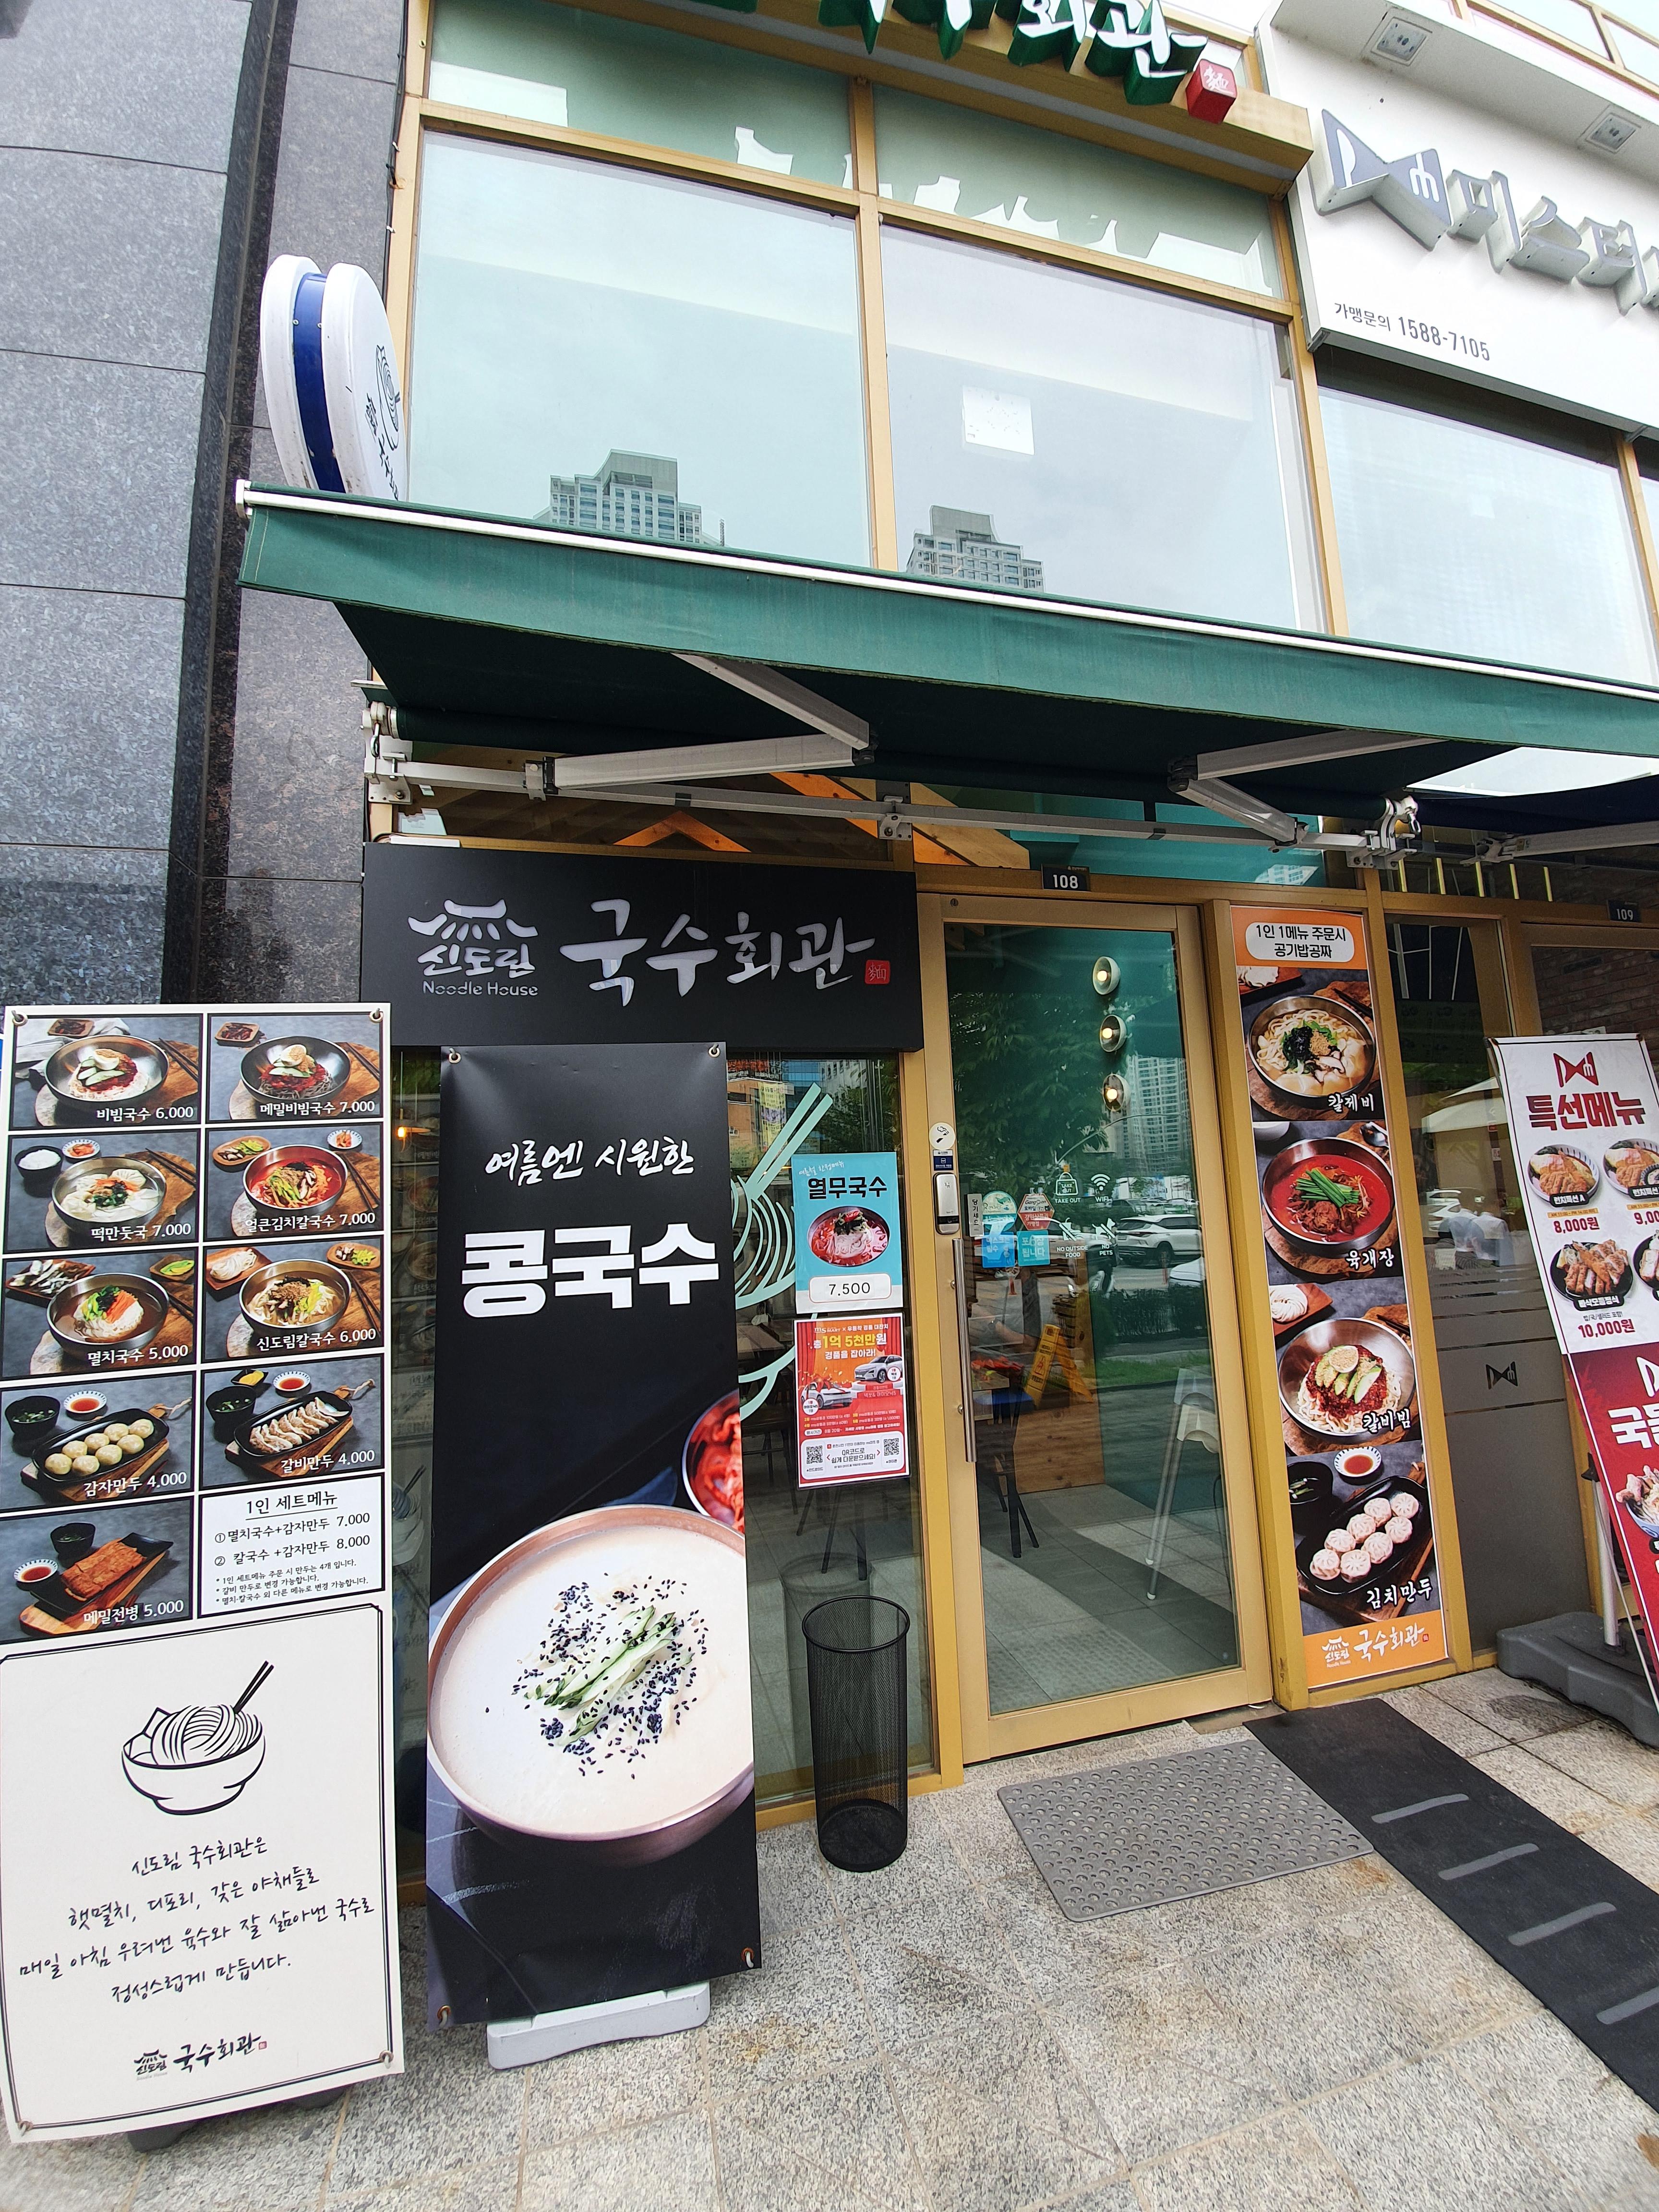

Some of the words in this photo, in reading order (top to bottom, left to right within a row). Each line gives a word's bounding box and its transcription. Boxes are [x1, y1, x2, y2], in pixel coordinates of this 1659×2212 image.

[1446, 170, 1659, 305] 미스터
[1334, 303, 1391, 331] 가맹문의
[1399, 317, 1490, 361] 1588-7105
[1053, 874, 1078, 889] 108
[1616, 908, 1634, 920] 109
[1255, 924, 1275, 939] 1인
[1278, 925, 1309, 940] 1메뉴
[1311, 926, 1346, 942] 주문시
[417, 943, 536, 978] 신도림
[559, 899, 876, 1008] 국수회관
[1274, 943, 1332, 959] 공기밥공짜
[423, 980, 483, 995] Noodle
[487, 982, 538, 996] House
[96, 1107, 152, 1122] 비빔국수
[156, 1106, 194, 1120] 6.000
[259, 1102, 336, 1118] 메밀비빔국수
[340, 1100, 375, 1114] 7.000
[1328, 1092, 1374, 1113] 칼제비
[1526, 1091, 1647, 1131] 특선메뉴
[484, 1139, 583, 1187] 여름엔
[595, 1136, 695, 1177] 시원한
[807, 1176, 888, 1200] 열무국수
[91, 1226, 148, 1242] 떡만둣국
[153, 1223, 192, 1238] 7.000
[245, 1214, 336, 1233] 얼큰김치칼국수
[339, 1211, 376, 1226] 7.000
[1553, 1217, 1600, 1234] 8,000원
[1022, 1248, 1045, 1258] 됩니다
[1346, 1248, 1395, 1270] 육개장
[461, 1223, 720, 1318] 콩국수
[828, 1281, 870, 1297] 7.500
[256, 1331, 336, 1352] 신도림칼국수
[339, 1328, 376, 1343] 6.000
[845, 1333, 887, 1347] 5천만원
[1578, 1319, 1635, 1338] 10,000원
[87, 1349, 144, 1367] 멸치국수
[148, 1345, 189, 1360] 5.000
[825, 1350, 848, 1360] 경품을
[851, 1348, 876, 1358] 잡아라!
[1362, 1408, 1411, 1433] 칼비빔
[280, 1455, 334, 1475] 갈비만두
[337, 1449, 375, 1466] 4.000
[842, 1447, 865, 1455] QR코드로
[84, 1477, 142, 1496] 감자만두
[147, 1471, 187, 1488] 4.000
[246, 1497, 270, 1515] 1인
[276, 1491, 338, 1510] 세트메뉴
[337, 1512, 371, 1527] 7.000
[233, 1549, 270, 1565] 칼국수
[337, 1535, 371, 1550] 8.000
[237, 1572, 266, 1583] 세트메뉴
[268, 1570, 284, 1578] 주문
[286, 1567, 293, 1575] 시
[295, 1564, 317, 1575] 만두는
[319, 1562, 331, 1570] 4개
[334, 1559, 357, 1570] 입니다.
[222, 1586, 237, 1596] 갈비
[240, 1583, 262, 1593] 만두로
[264, 1579, 278, 1590] 변경
[281, 1575, 319, 1586] 가능합니다.
[264, 1590, 270, 1599] 외
[273, 1588, 288, 1597] 다른
[290, 1585, 312, 1595] 메뉴로
[314, 1582, 328, 1591] 변경
[331, 1576, 369, 1588] 가능합니다.
[1366, 1578, 1432, 1610] 김치만두
[84, 1604, 139, 1625] 메밀전병
[144, 1600, 184, 1617] 5.000
[1353, 1622, 1425, 1663] 국수회관
[1325, 1647, 1350, 1663] 신도림
[132, 1852, 181, 1876] 신도림
[189, 1837, 268, 1869] 국수회관은
[68, 1900, 136, 1931] 햇멸치,
[147, 1892, 200, 1911] 디포리,
[211, 1881, 244, 1903] 갖은
[252, 1866, 320, 1892] 야채들로
[20, 1952, 63, 1980] 매일
[70, 1945, 111, 1968] 아침
[181, 1926, 231, 1951] 육수와
[240, 1914, 262, 1940] 잘
[335, 1897, 375, 1922] 국수로
[111, 1970, 205, 2004] 정성스럽게
[216, 1953, 291, 1981] 만듭니다.
[173, 2032, 262, 2074] 국수회관
[136, 2059, 167, 2076] 신도림
